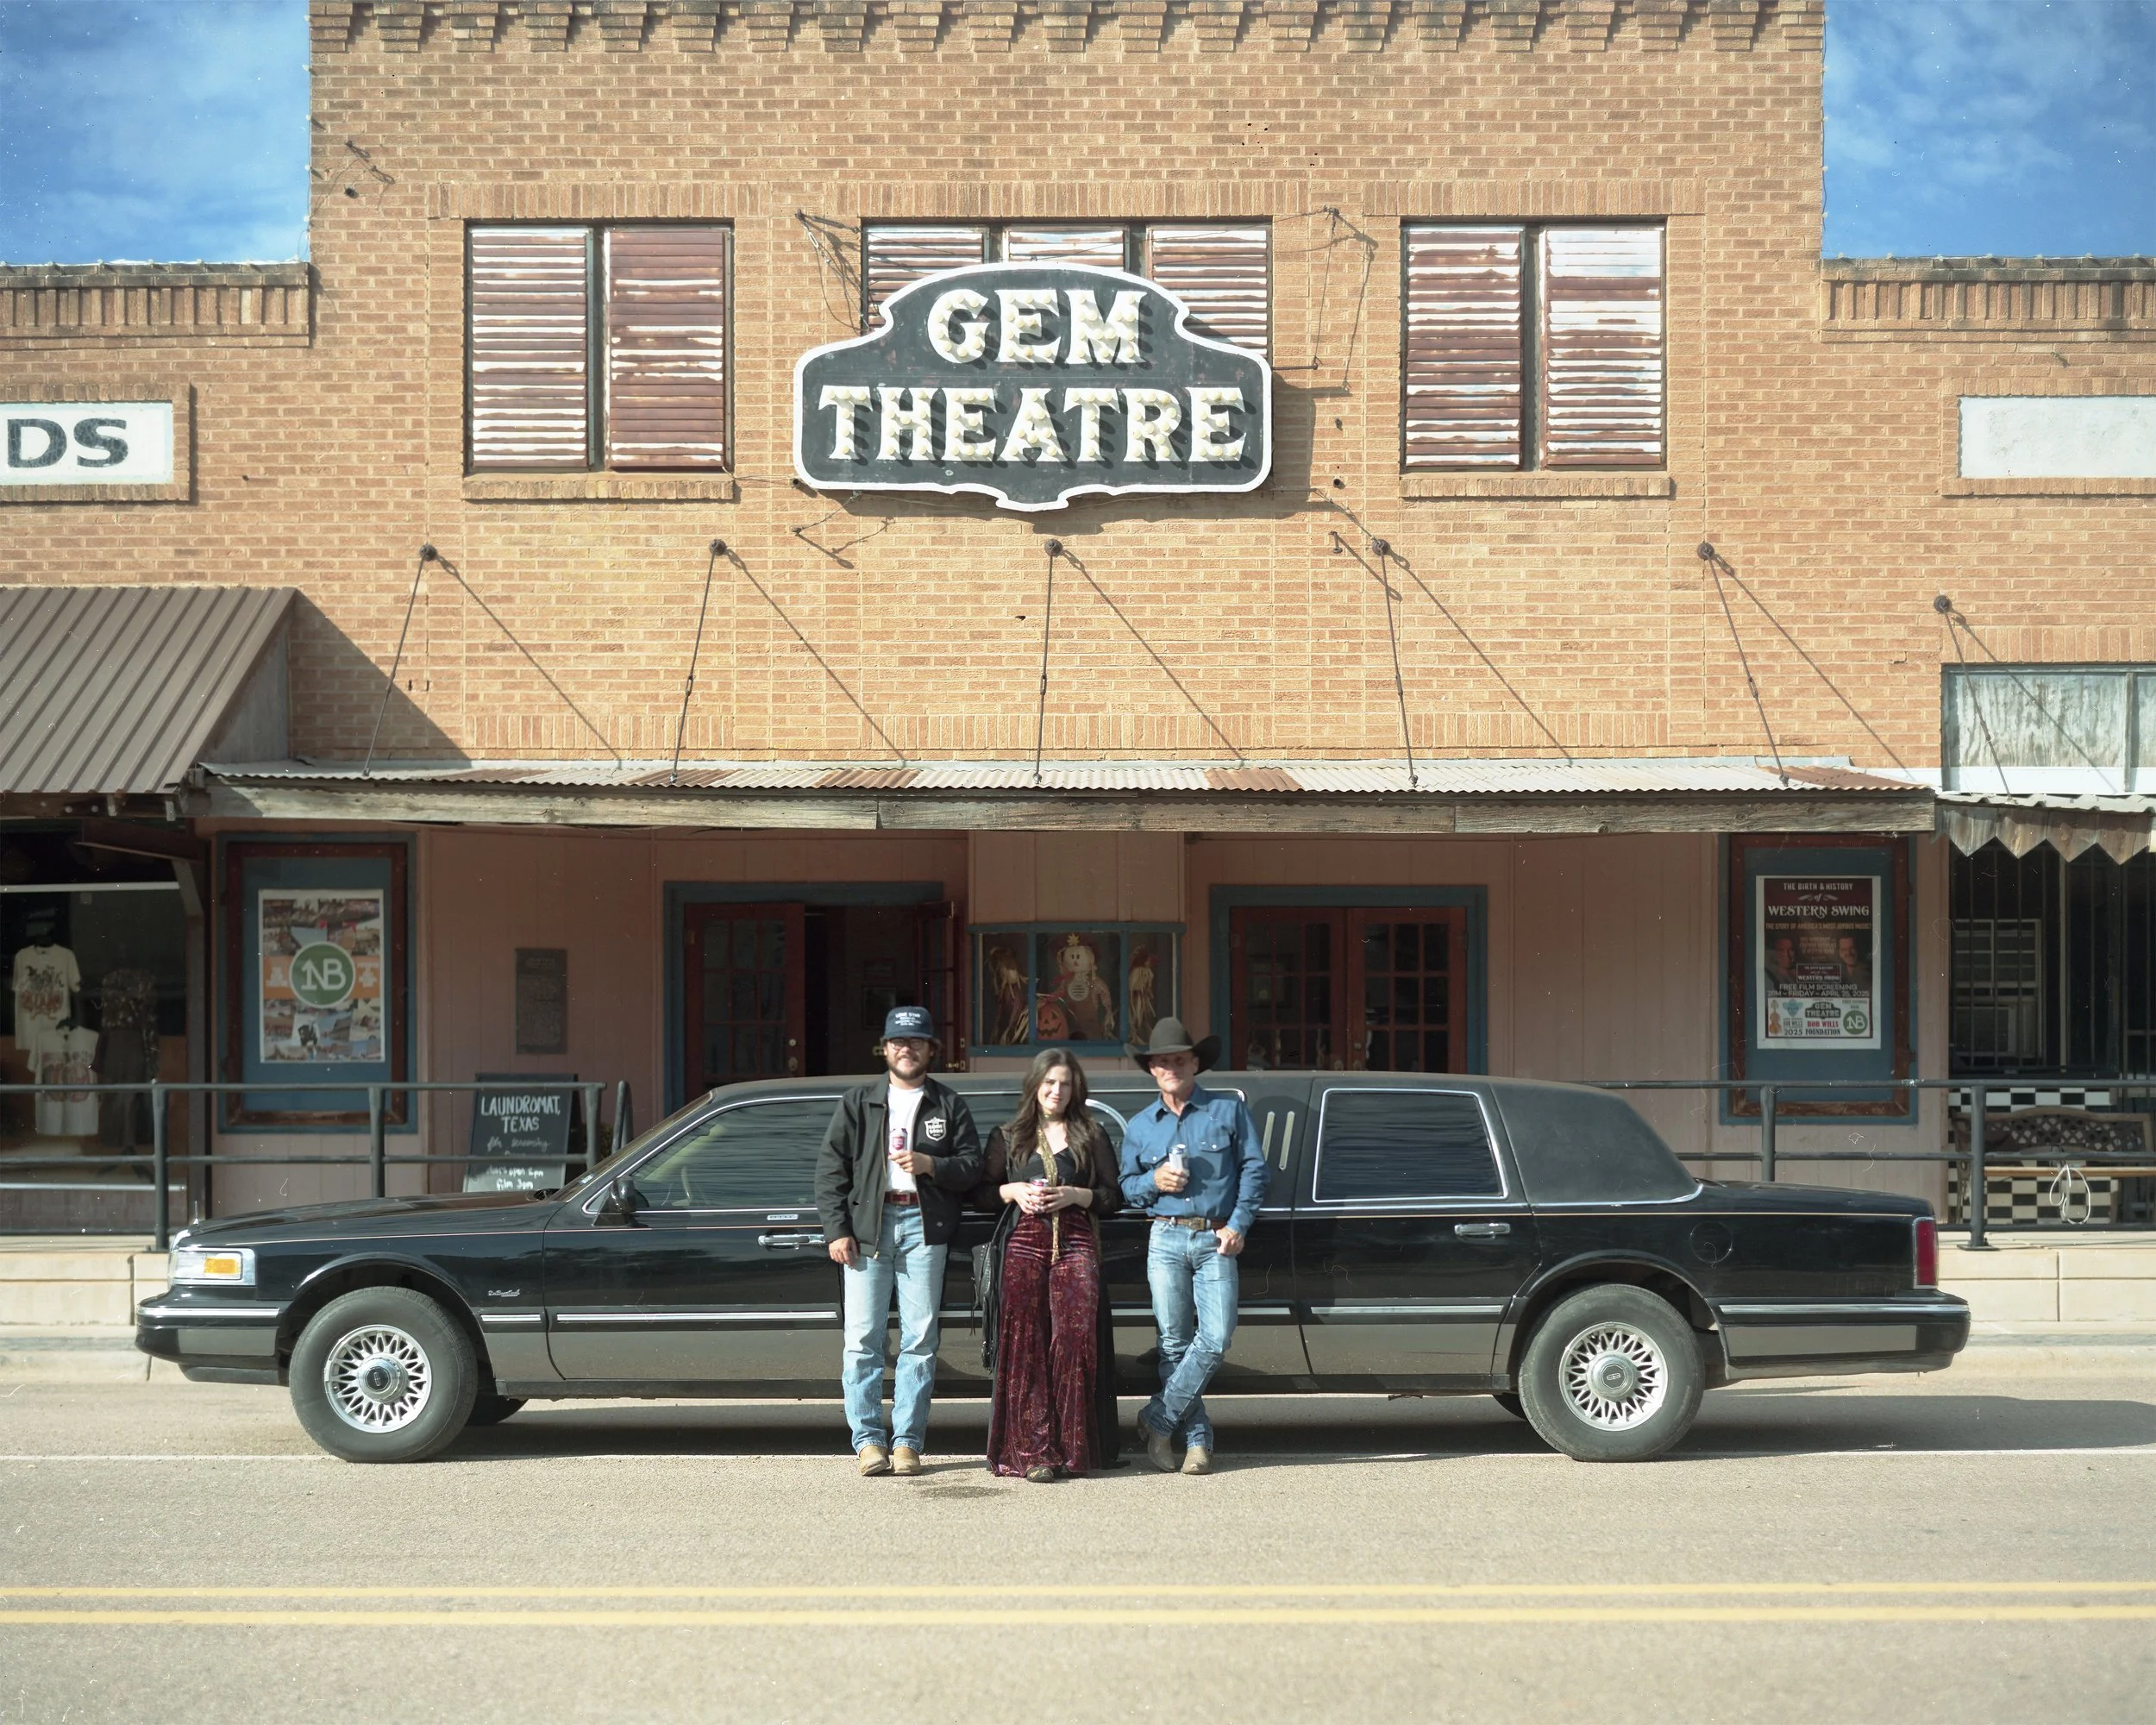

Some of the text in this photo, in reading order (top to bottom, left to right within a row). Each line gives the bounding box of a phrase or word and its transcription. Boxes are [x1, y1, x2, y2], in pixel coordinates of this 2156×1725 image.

[928, 288, 1149, 365] GEM
[818, 385, 1247, 462] THEATRE
[7, 417, 128, 467] DS
[1783, 882, 1853, 891] THE BIRTH & HISTORY
[1767, 906, 1870, 919] WESTERN SWING
[501, 1116, 540, 1133] TEXAS
